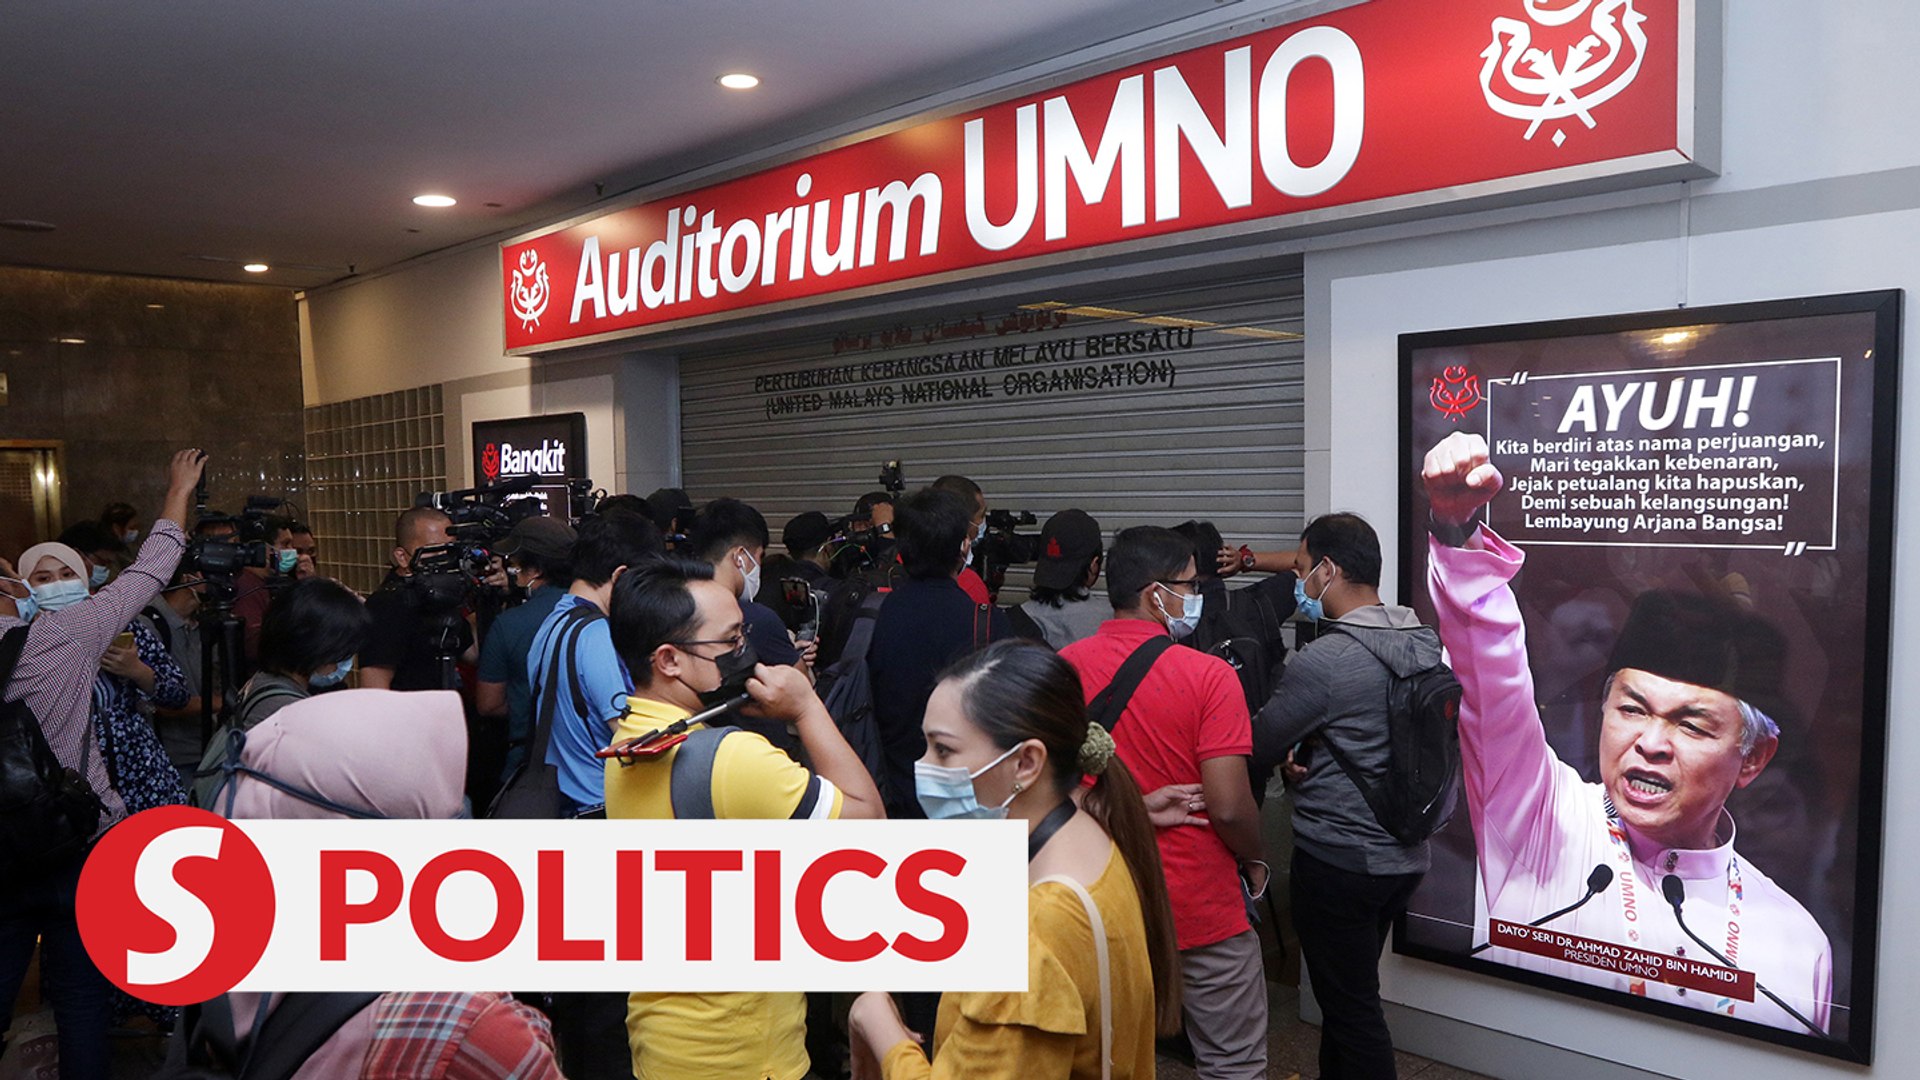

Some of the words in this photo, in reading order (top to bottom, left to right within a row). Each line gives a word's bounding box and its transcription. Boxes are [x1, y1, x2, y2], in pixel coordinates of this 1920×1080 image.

[569, 173, 943, 324] Auditorium
[964, 25, 1364, 251] UMNO
[755, 361, 857, 394] PERTUBUHAN
[861, 349, 985, 383] KEBANGSAAN
[993, 338, 1076, 368] MELAYU
[1085, 326, 1194, 358] BERSATU
[766, 392, 824, 421] (UNITED
[829, 384, 894, 410] MALAYS
[902, 375, 993, 404] NATIONAL
[1003, 358, 1176, 396] ORGANISATION)
[1557, 375, 1758, 433] AYUH!
[1496, 439, 1529, 454] Kita
[1533, 437, 1592, 453] berdiri
[1596, 437, 1634, 452] atas
[1639, 437, 1692, 451] nama
[1697, 432, 1826, 454] perjuangan,
[1509, 475, 1554, 494] Jejak
[1557, 474, 1650, 494] petualang
[1655, 473, 1692, 490] kita
[1697, 472, 1805, 493] hapuskan,
[1530, 456, 1570, 472] Mari
[1573, 455, 1660, 475] tegakkan
[1665, 453, 1780, 471] kebenaran,
[1521, 495, 1567, 510] Demi
[1570, 494, 1636, 510] sebuah
[1641, 493, 1790, 514] kelangsungan!
[1525, 513, 1629, 533] Lembayung
[1633, 514, 1697, 533] Arjana
[1702, 514, 1784, 535] Bangsa!
[1619, 871, 1638, 922] UMNO
[1497, 923, 1530, 938] DATO'
[1532, 931, 1554, 944] SERI
[1623, 949, 1663, 967] ZAHID
[1666, 960, 1688, 973] BIN
[1691, 965, 1738, 984] HAMIDI
[1564, 948, 1617, 969] PRESIDEN
[1619, 960, 1659, 979] UMNO
